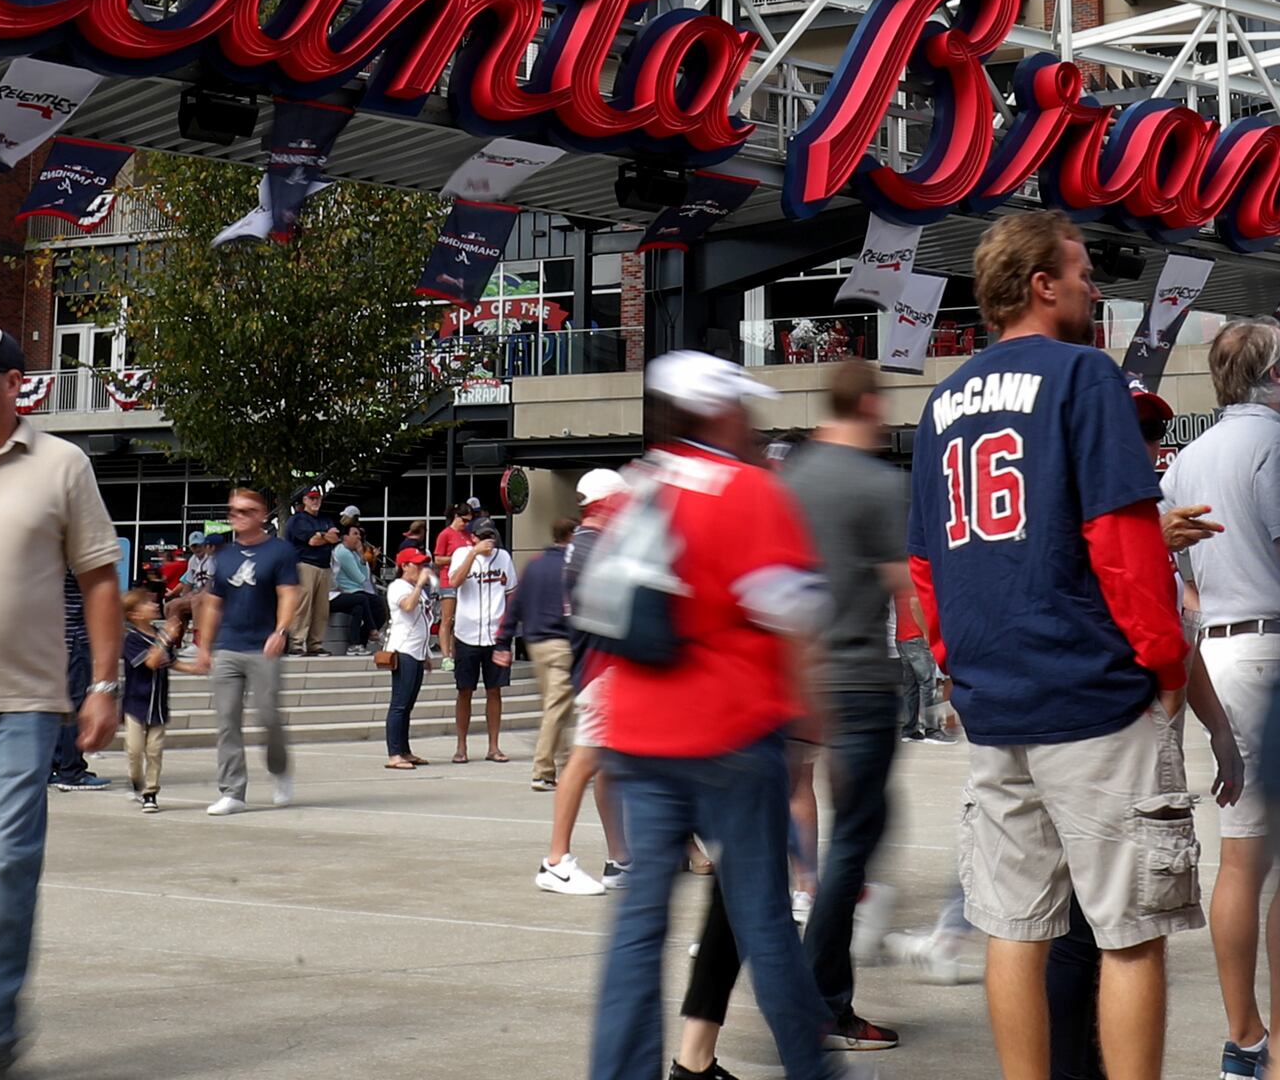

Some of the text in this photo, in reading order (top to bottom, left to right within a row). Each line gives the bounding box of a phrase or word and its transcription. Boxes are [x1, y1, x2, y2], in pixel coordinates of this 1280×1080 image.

[490, 301, 513, 316] OF
[520, 301, 551, 319] THE
[452, 384, 510, 406] TERRAPIN
[933, 372, 1042, 435] McCANN
[943, 427, 1027, 549] 16
